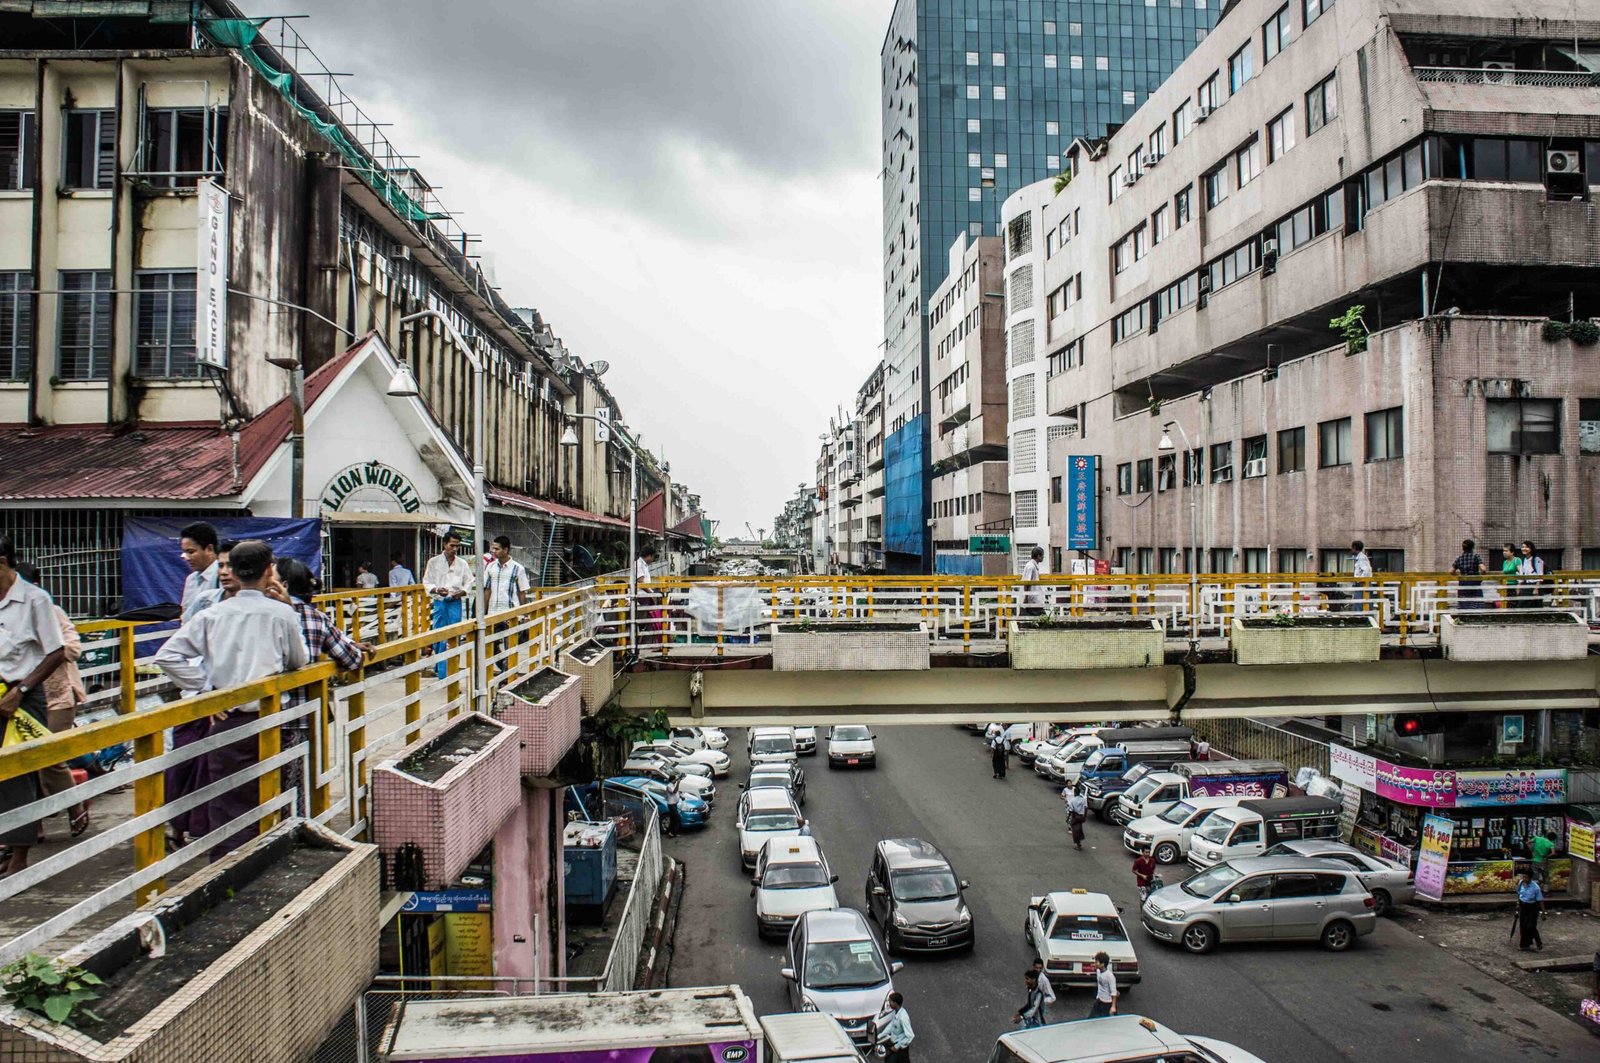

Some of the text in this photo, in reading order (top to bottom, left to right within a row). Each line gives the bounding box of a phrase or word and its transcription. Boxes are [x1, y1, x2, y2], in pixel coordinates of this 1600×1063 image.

[210, 216, 218, 276] GANO
[322, 466, 420, 513] LION WORLD
[726, 1050, 743, 1059] EMP
